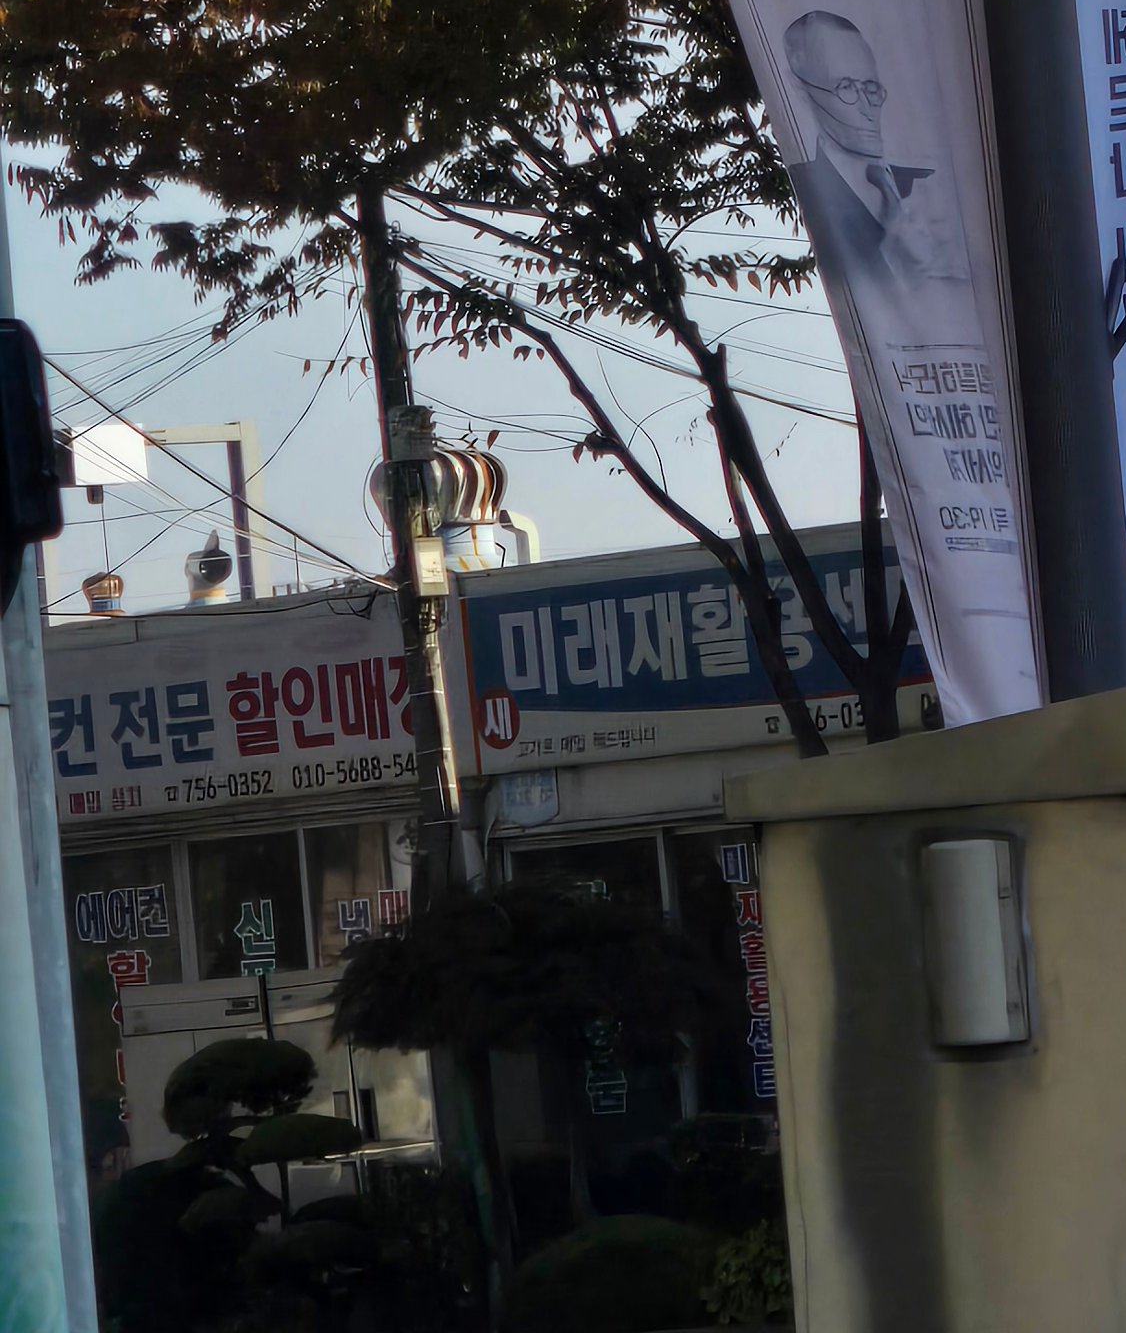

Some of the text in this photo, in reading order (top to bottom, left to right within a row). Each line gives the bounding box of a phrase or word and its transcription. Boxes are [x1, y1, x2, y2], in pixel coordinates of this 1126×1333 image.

[109, 680, 214, 770] 전문
[182, 770, 275, 803] 756-0352
[75, 883, 171, 944] 에어컨
